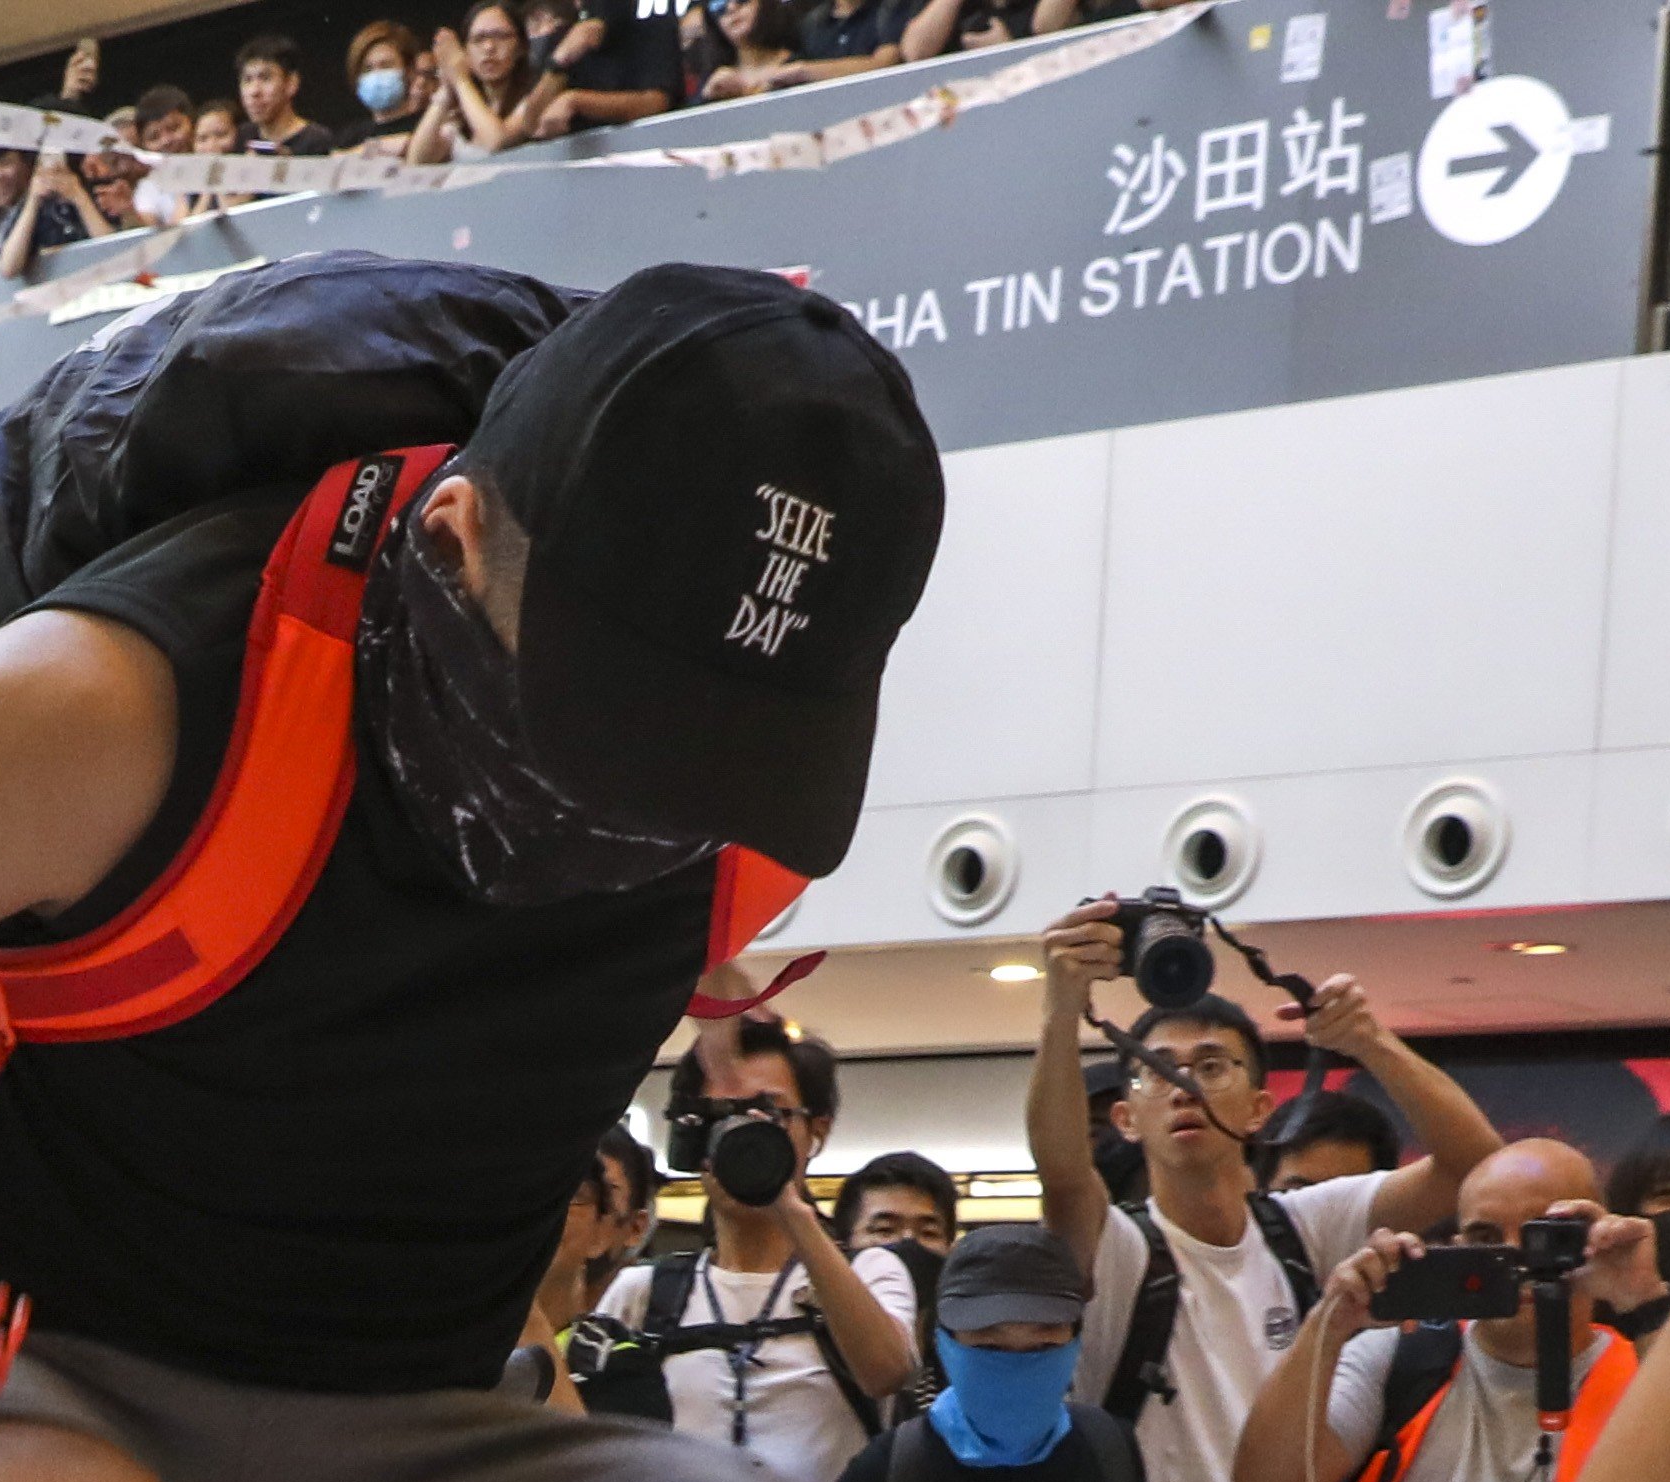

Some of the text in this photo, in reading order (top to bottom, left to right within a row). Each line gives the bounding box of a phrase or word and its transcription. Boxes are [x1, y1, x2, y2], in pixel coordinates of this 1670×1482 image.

[1103, 96, 1368, 236] 沙田站
[840, 212, 1364, 350] HA TIN STATION
[332, 463, 380, 557] LOAD
[756, 552, 810, 604] THE
